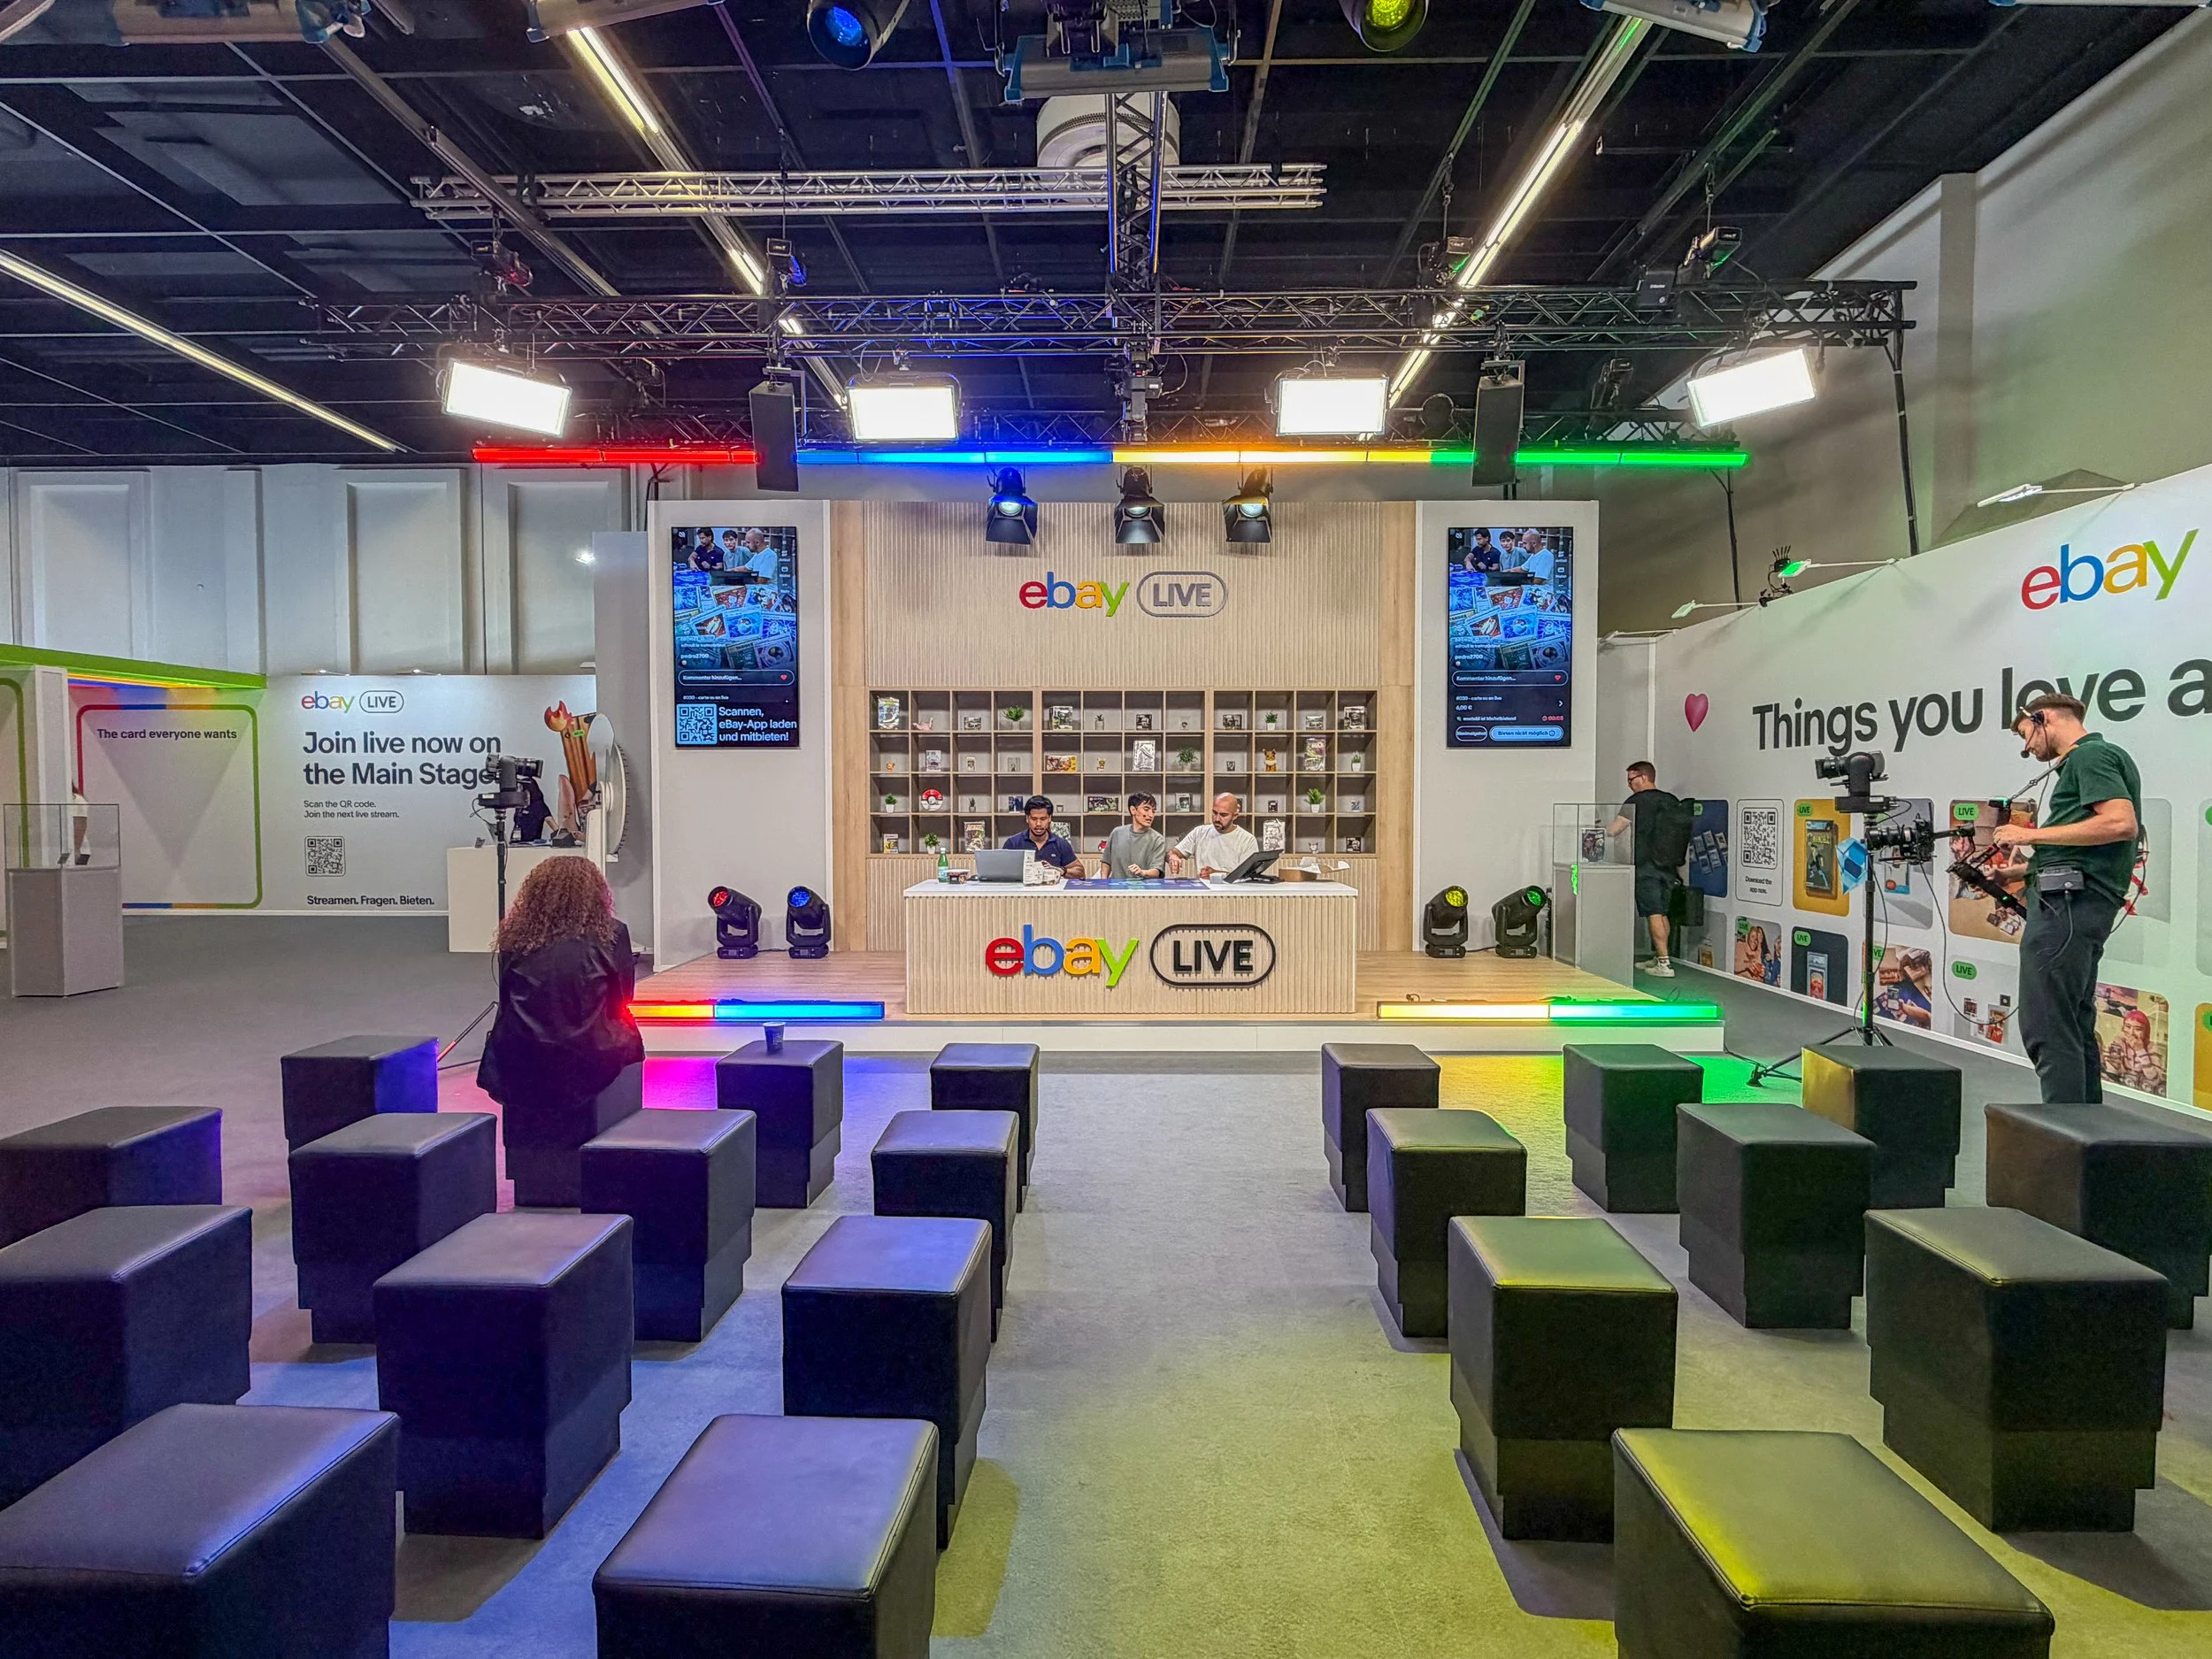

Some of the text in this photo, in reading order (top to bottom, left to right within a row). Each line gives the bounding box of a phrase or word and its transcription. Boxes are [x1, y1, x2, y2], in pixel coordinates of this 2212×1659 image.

[2021, 528, 2200, 611] ebay
[1018, 571, 1212, 618] ebay LIVE
[301, 690, 396, 713] ebay LIVE
[718, 706, 764, 718] Scannen,
[718, 718, 797, 731] eBay-App laden
[1752, 696, 1878, 757] Things
[1887, 687, 1984, 753] you
[96, 728, 238, 741] The card everyone wants
[718, 732, 789, 741] und mitbieten!
[303, 731, 502, 754] Join live now on
[303, 763, 346, 785] the
[352, 762, 413, 785] Main
[303, 800, 377, 809] Scan the QR code.
[1799, 805, 1810, 815] LIVE
[1958, 806, 1975, 817] LIVE
[306, 895, 435, 907] Streamen. Fragen. Bieten.
[1796, 934, 1809, 943] LIVE
[986, 924, 1254, 987] ebay LIVE
[1955, 964, 1973, 976] LIVE
